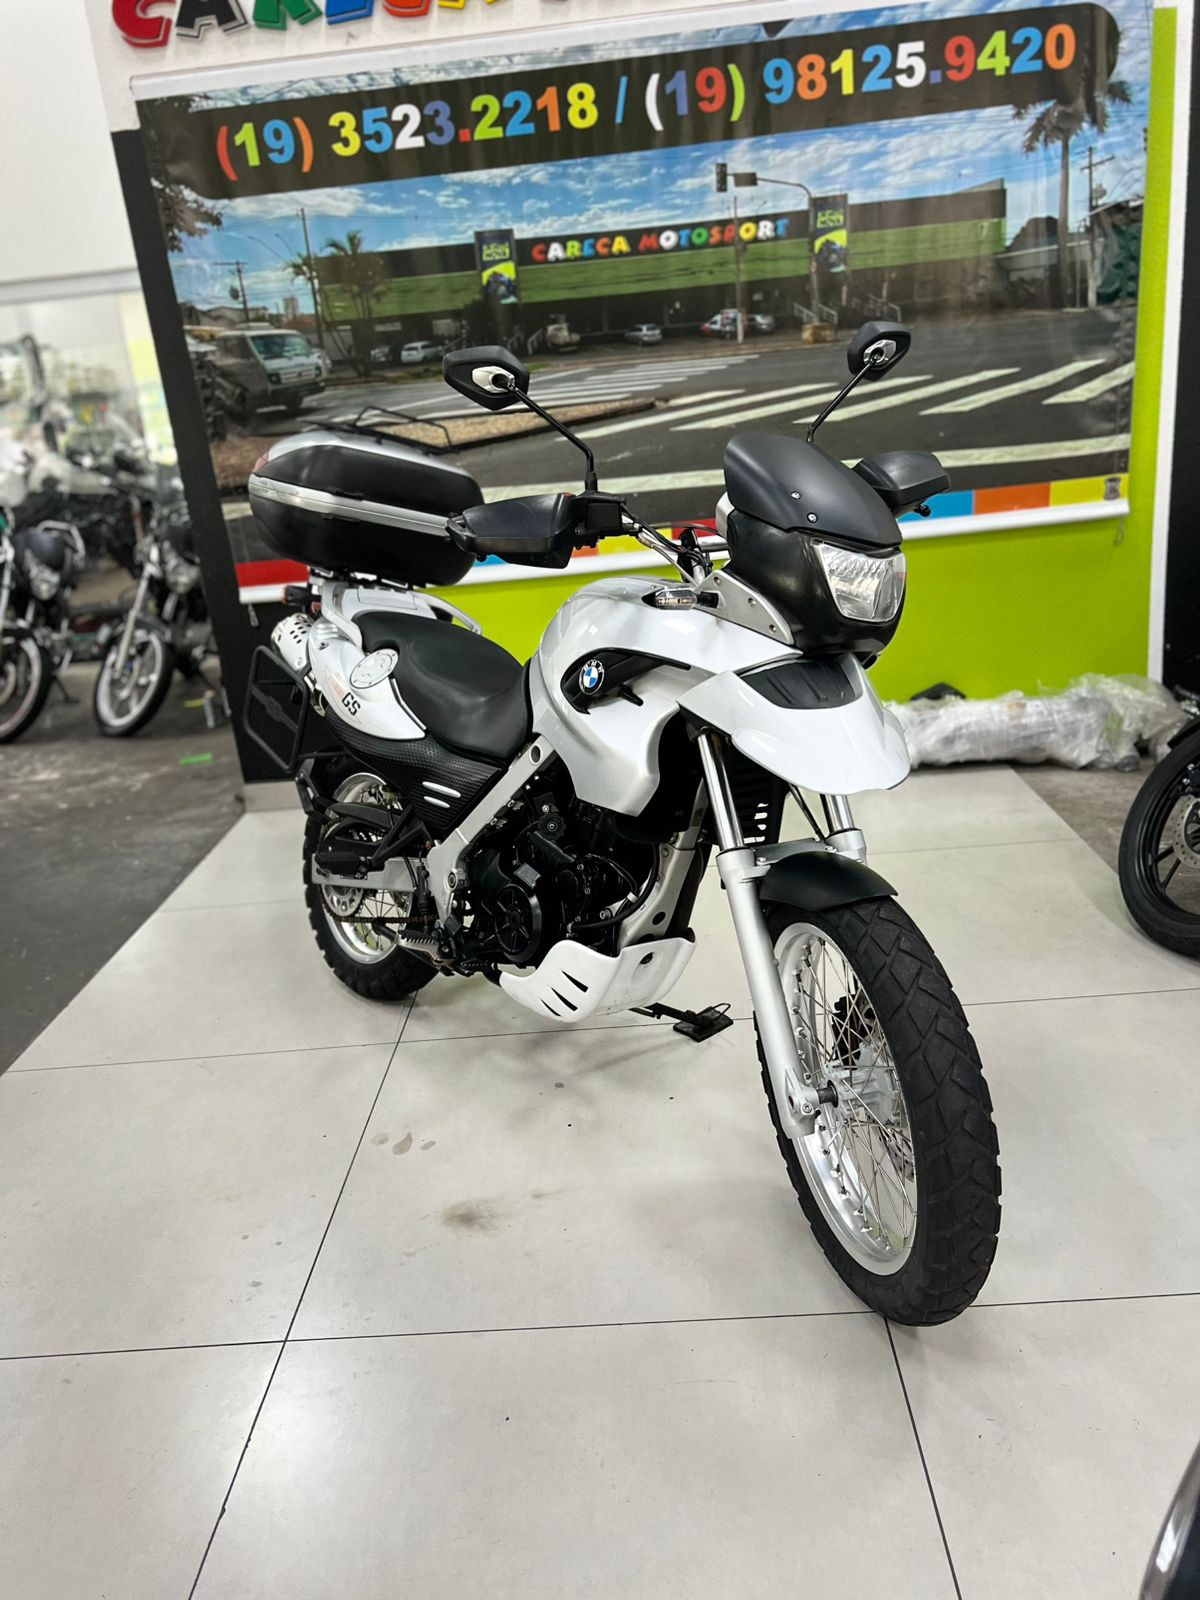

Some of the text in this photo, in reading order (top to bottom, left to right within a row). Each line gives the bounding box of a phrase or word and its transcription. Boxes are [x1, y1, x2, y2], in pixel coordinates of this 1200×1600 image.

[217, 24, 1076, 181] (19) 3523.2218 / (19) 98125.9420
[531, 235, 631, 263] CARECA
[639, 218, 790, 252] MOTOSPORT
[341, 692, 361, 716] GS
